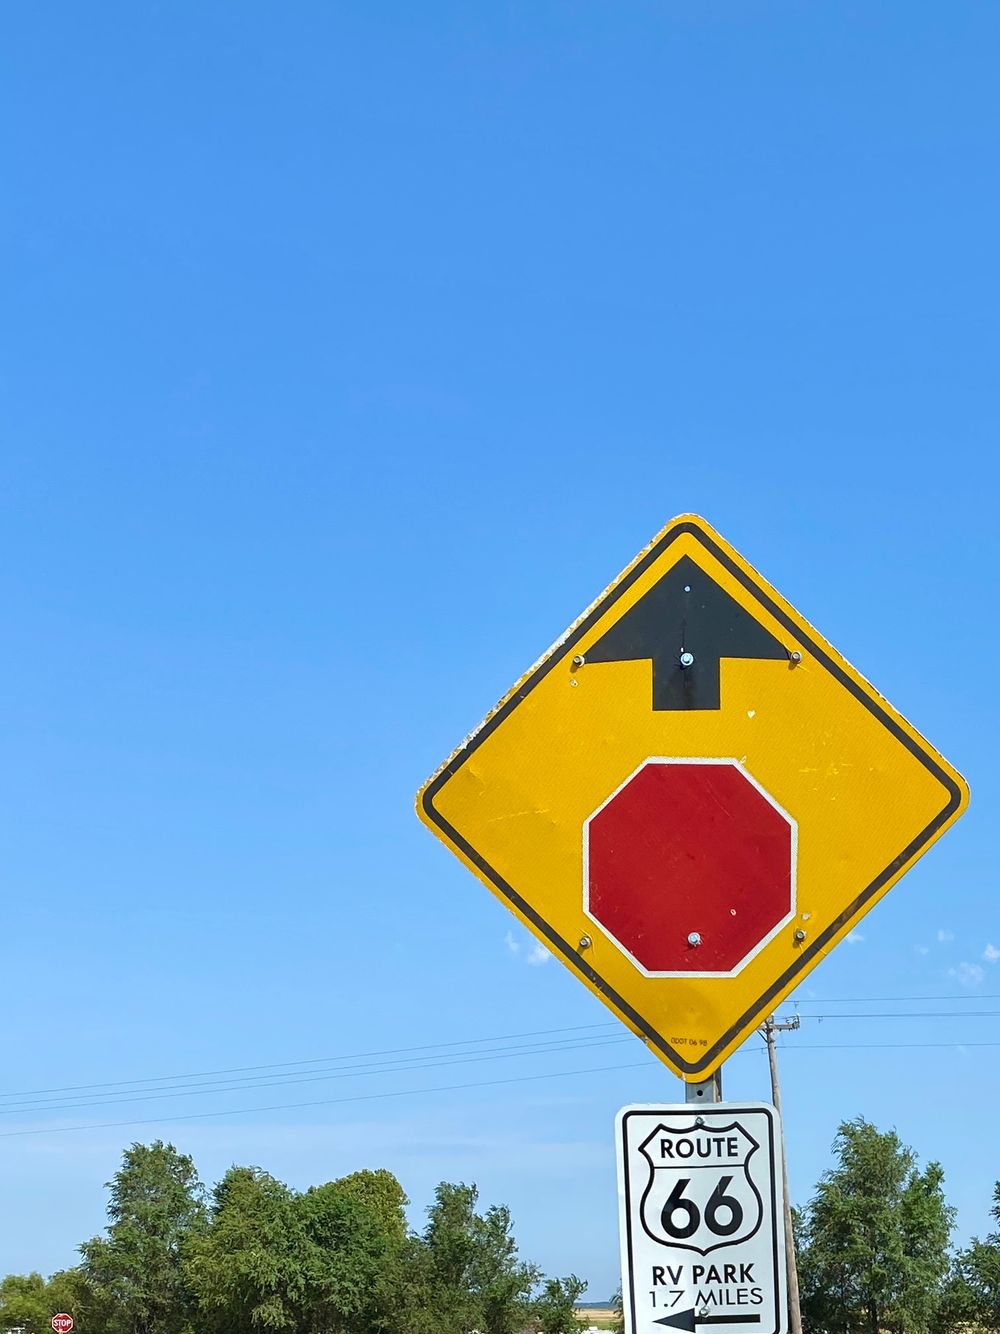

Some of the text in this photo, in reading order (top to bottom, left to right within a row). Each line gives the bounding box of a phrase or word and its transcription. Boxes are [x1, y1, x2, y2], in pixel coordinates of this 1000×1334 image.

[660, 1137, 739, 1159] ROUTE
[660, 1175, 744, 1239] 66
[652, 1263, 756, 1286] RV PARK
[649, 1287, 763, 1308] 1.7 MILES
[53, 1319, 71, 1327] STOP
